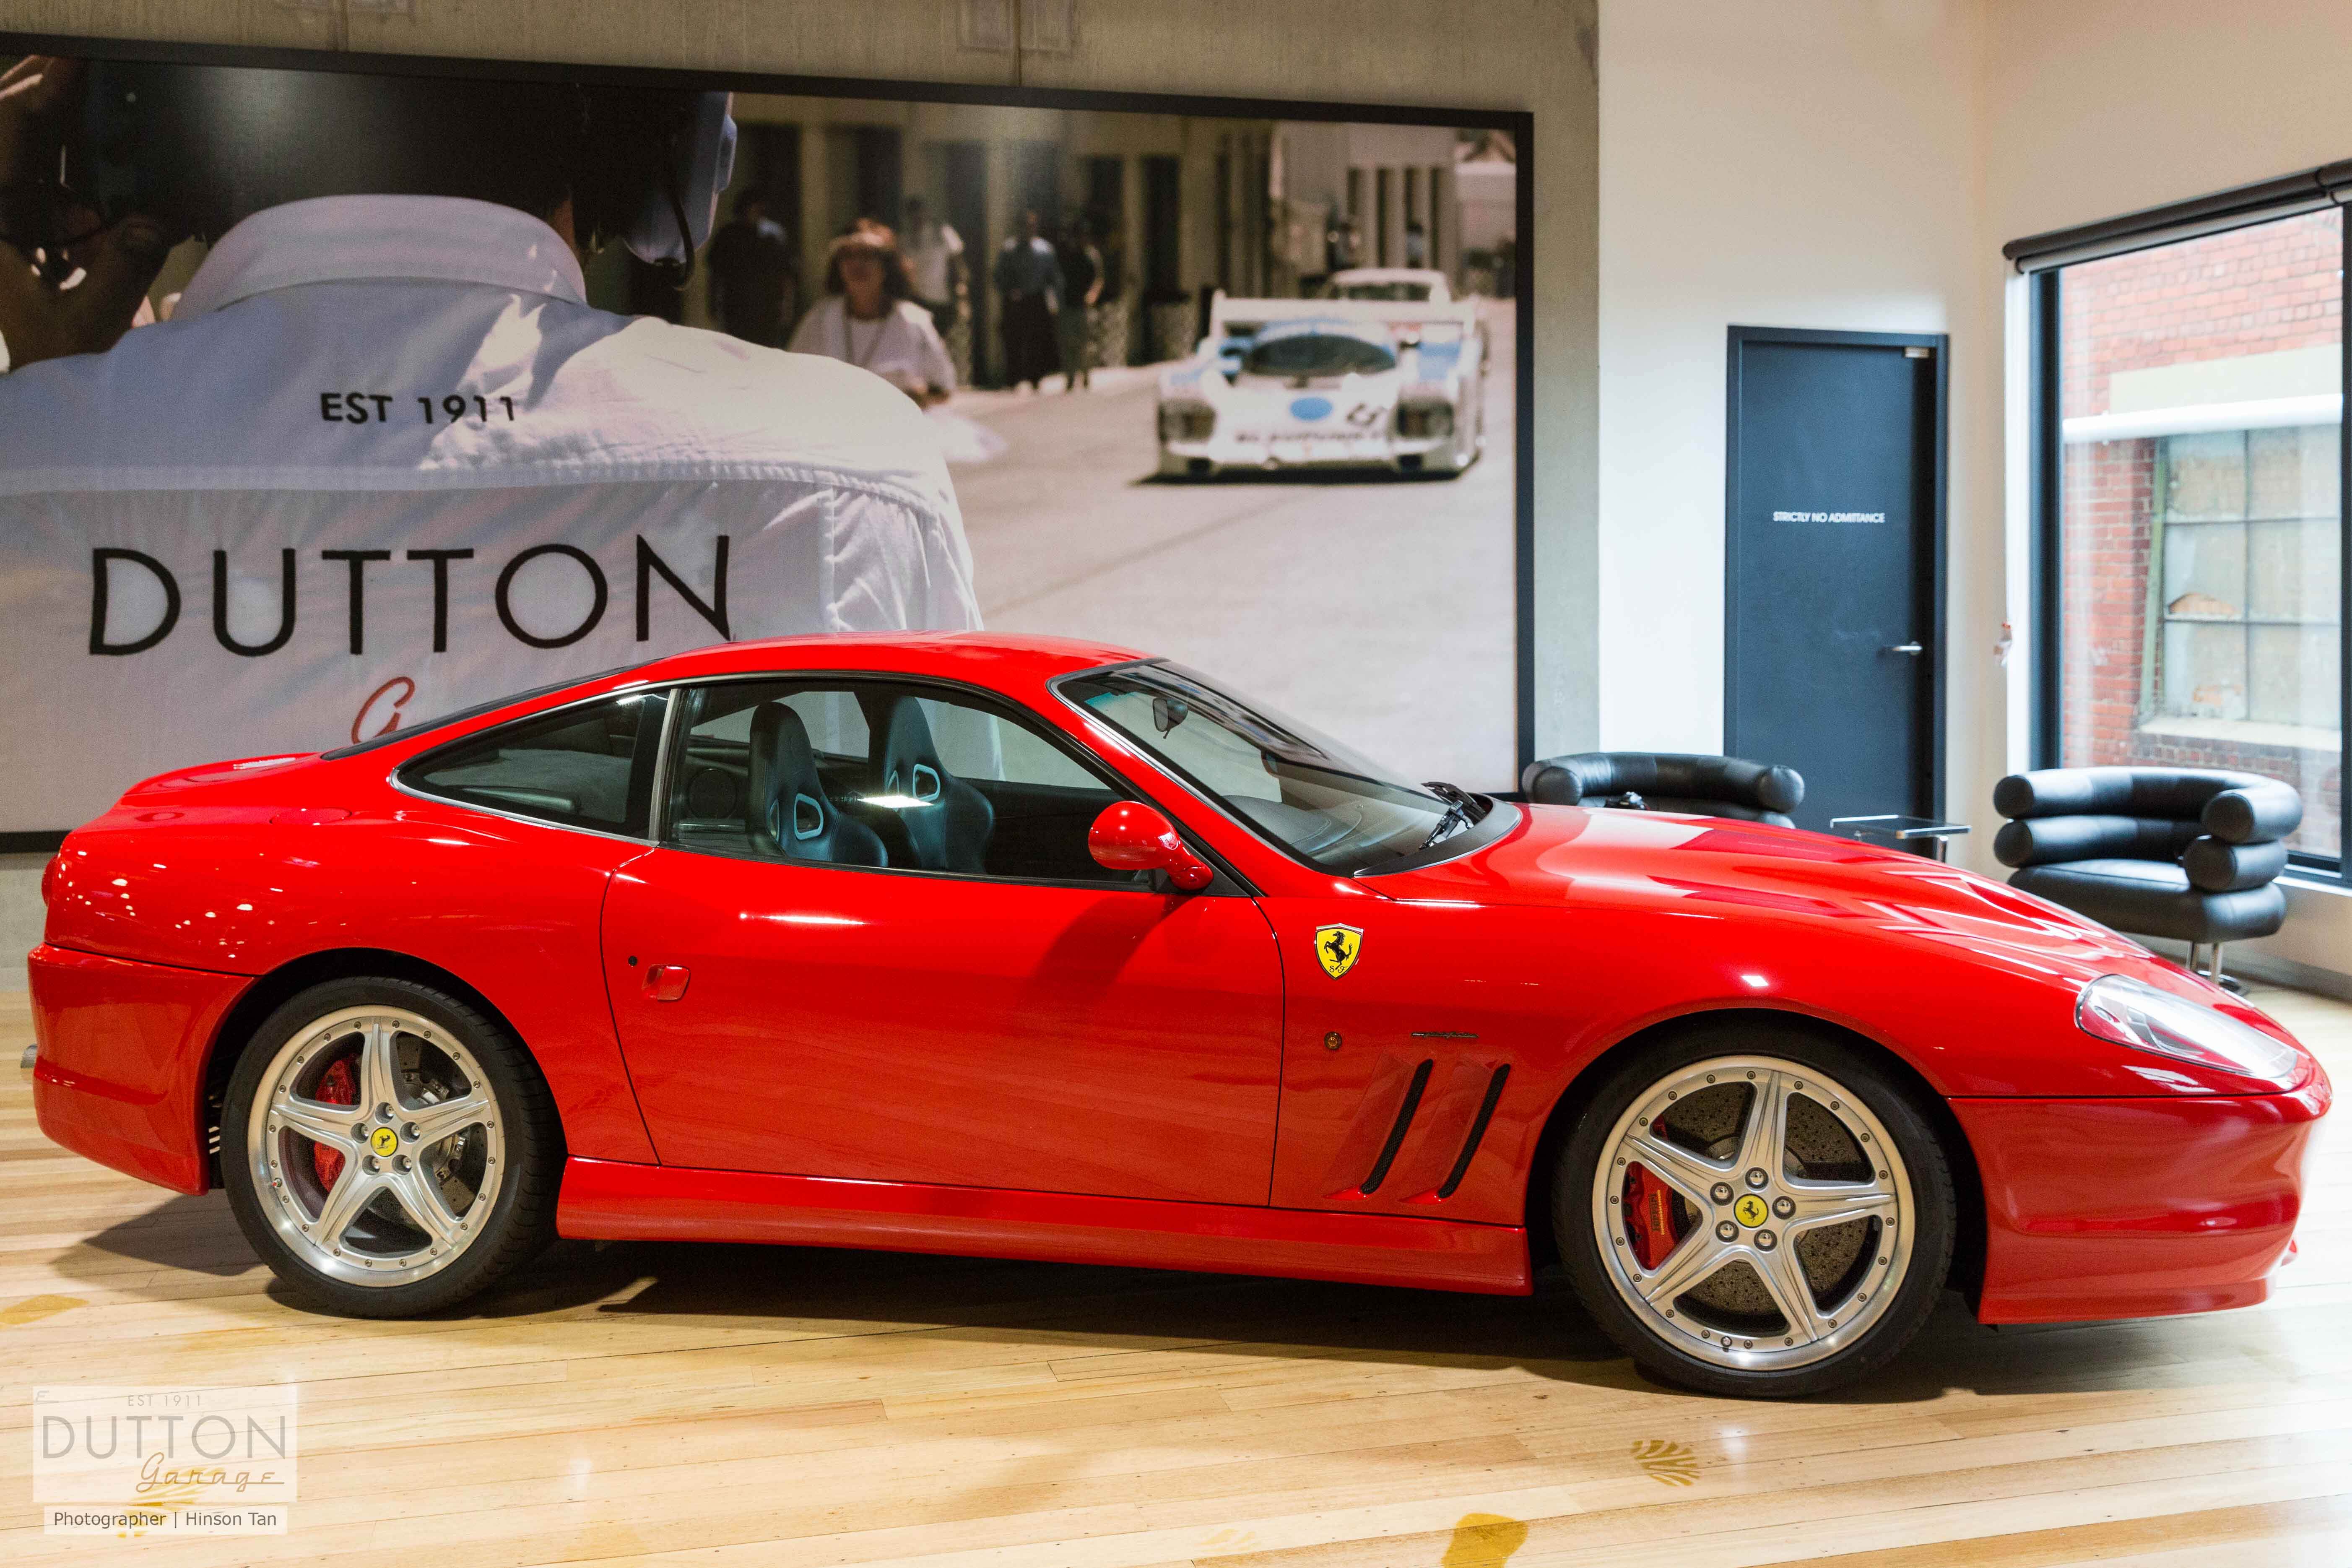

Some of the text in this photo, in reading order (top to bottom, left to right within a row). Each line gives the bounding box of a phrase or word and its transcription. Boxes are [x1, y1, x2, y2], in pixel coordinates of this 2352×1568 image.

[320, 392, 515, 424] EST 1911
[1773, 511, 1811, 522] STRICTLY
[1811, 512, 1828, 523] NO
[90, 535, 731, 656] DUTTON
